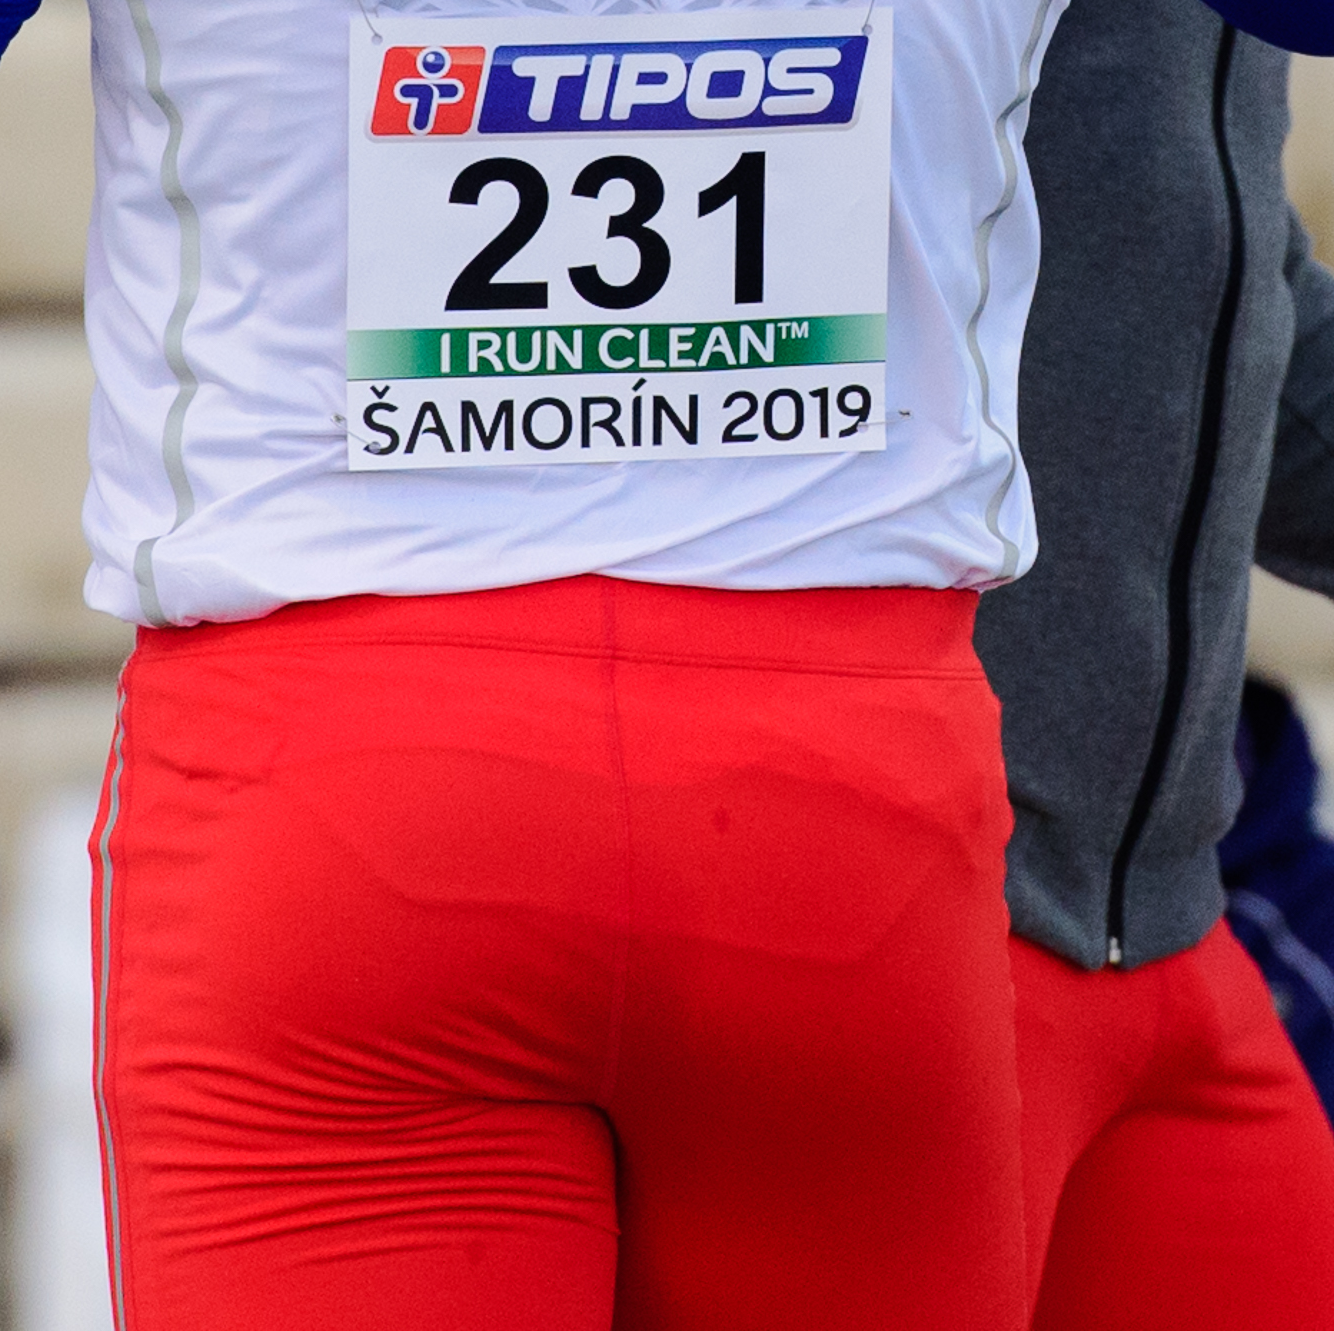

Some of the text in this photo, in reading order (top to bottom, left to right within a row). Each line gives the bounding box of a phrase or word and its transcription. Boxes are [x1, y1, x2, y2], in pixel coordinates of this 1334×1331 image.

[511, 47, 842, 123] TIPOS
[444, 151, 766, 312] 231
[439, 332, 452, 373] I
[467, 330, 584, 373] RUN
[362, 377, 873, 456] ŠAMORÍN 2019
